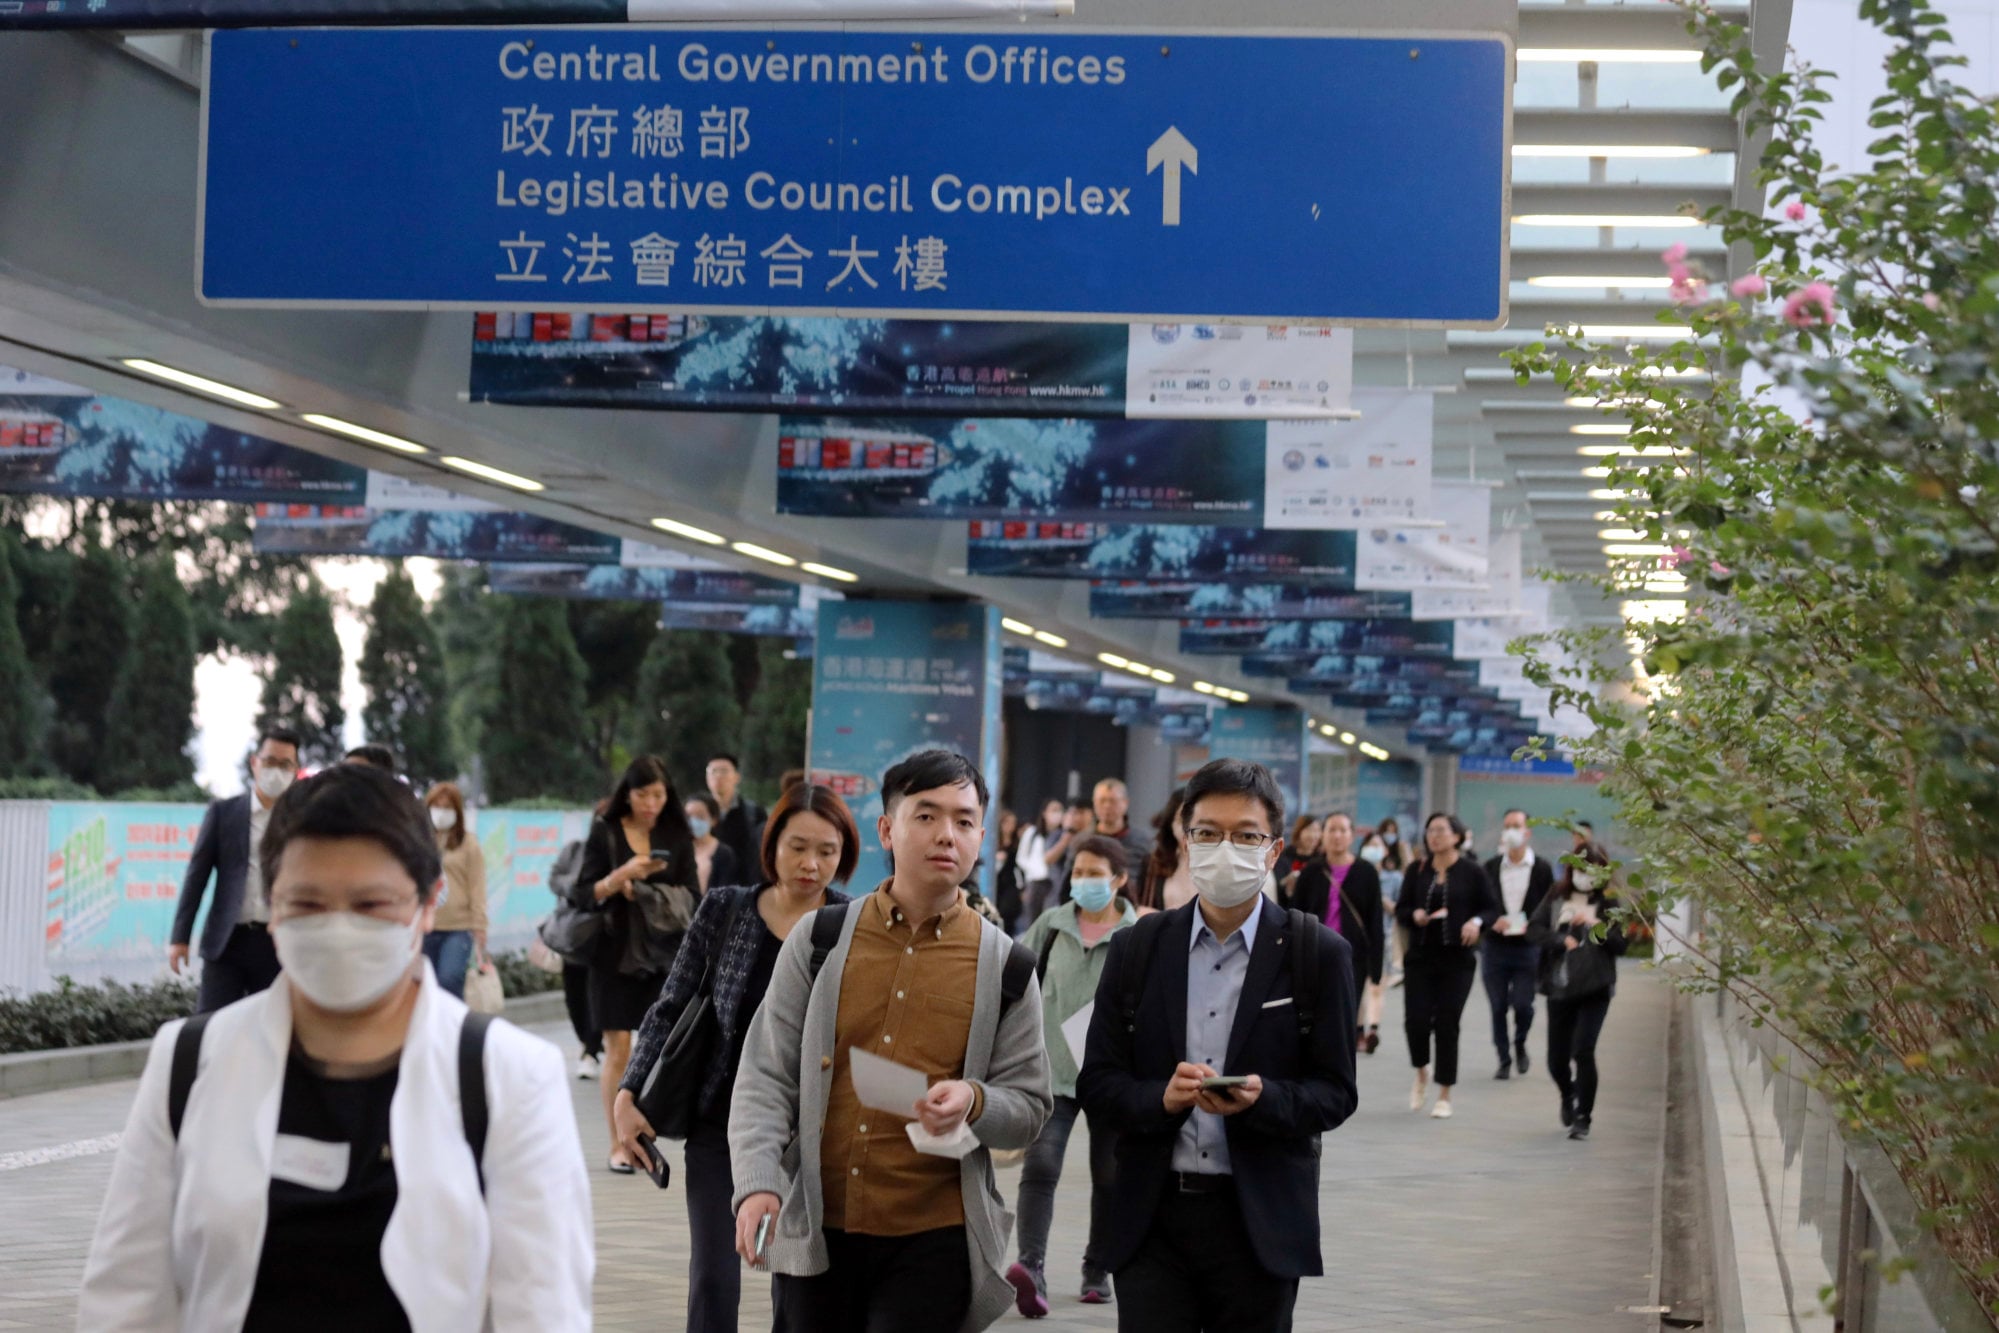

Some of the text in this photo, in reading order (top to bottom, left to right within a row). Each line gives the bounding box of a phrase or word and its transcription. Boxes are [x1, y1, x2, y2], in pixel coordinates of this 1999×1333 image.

[498, 41, 1127, 85] Central Government Offices
[501, 103, 751, 159] 政府總部
[496, 169, 1131, 221] Legislative Council Complex
[495, 230, 949, 291] 立法會綜合大樓
[944, 384, 976, 396] Propel
[1029, 383, 1106, 397] www.hkmw.hk
